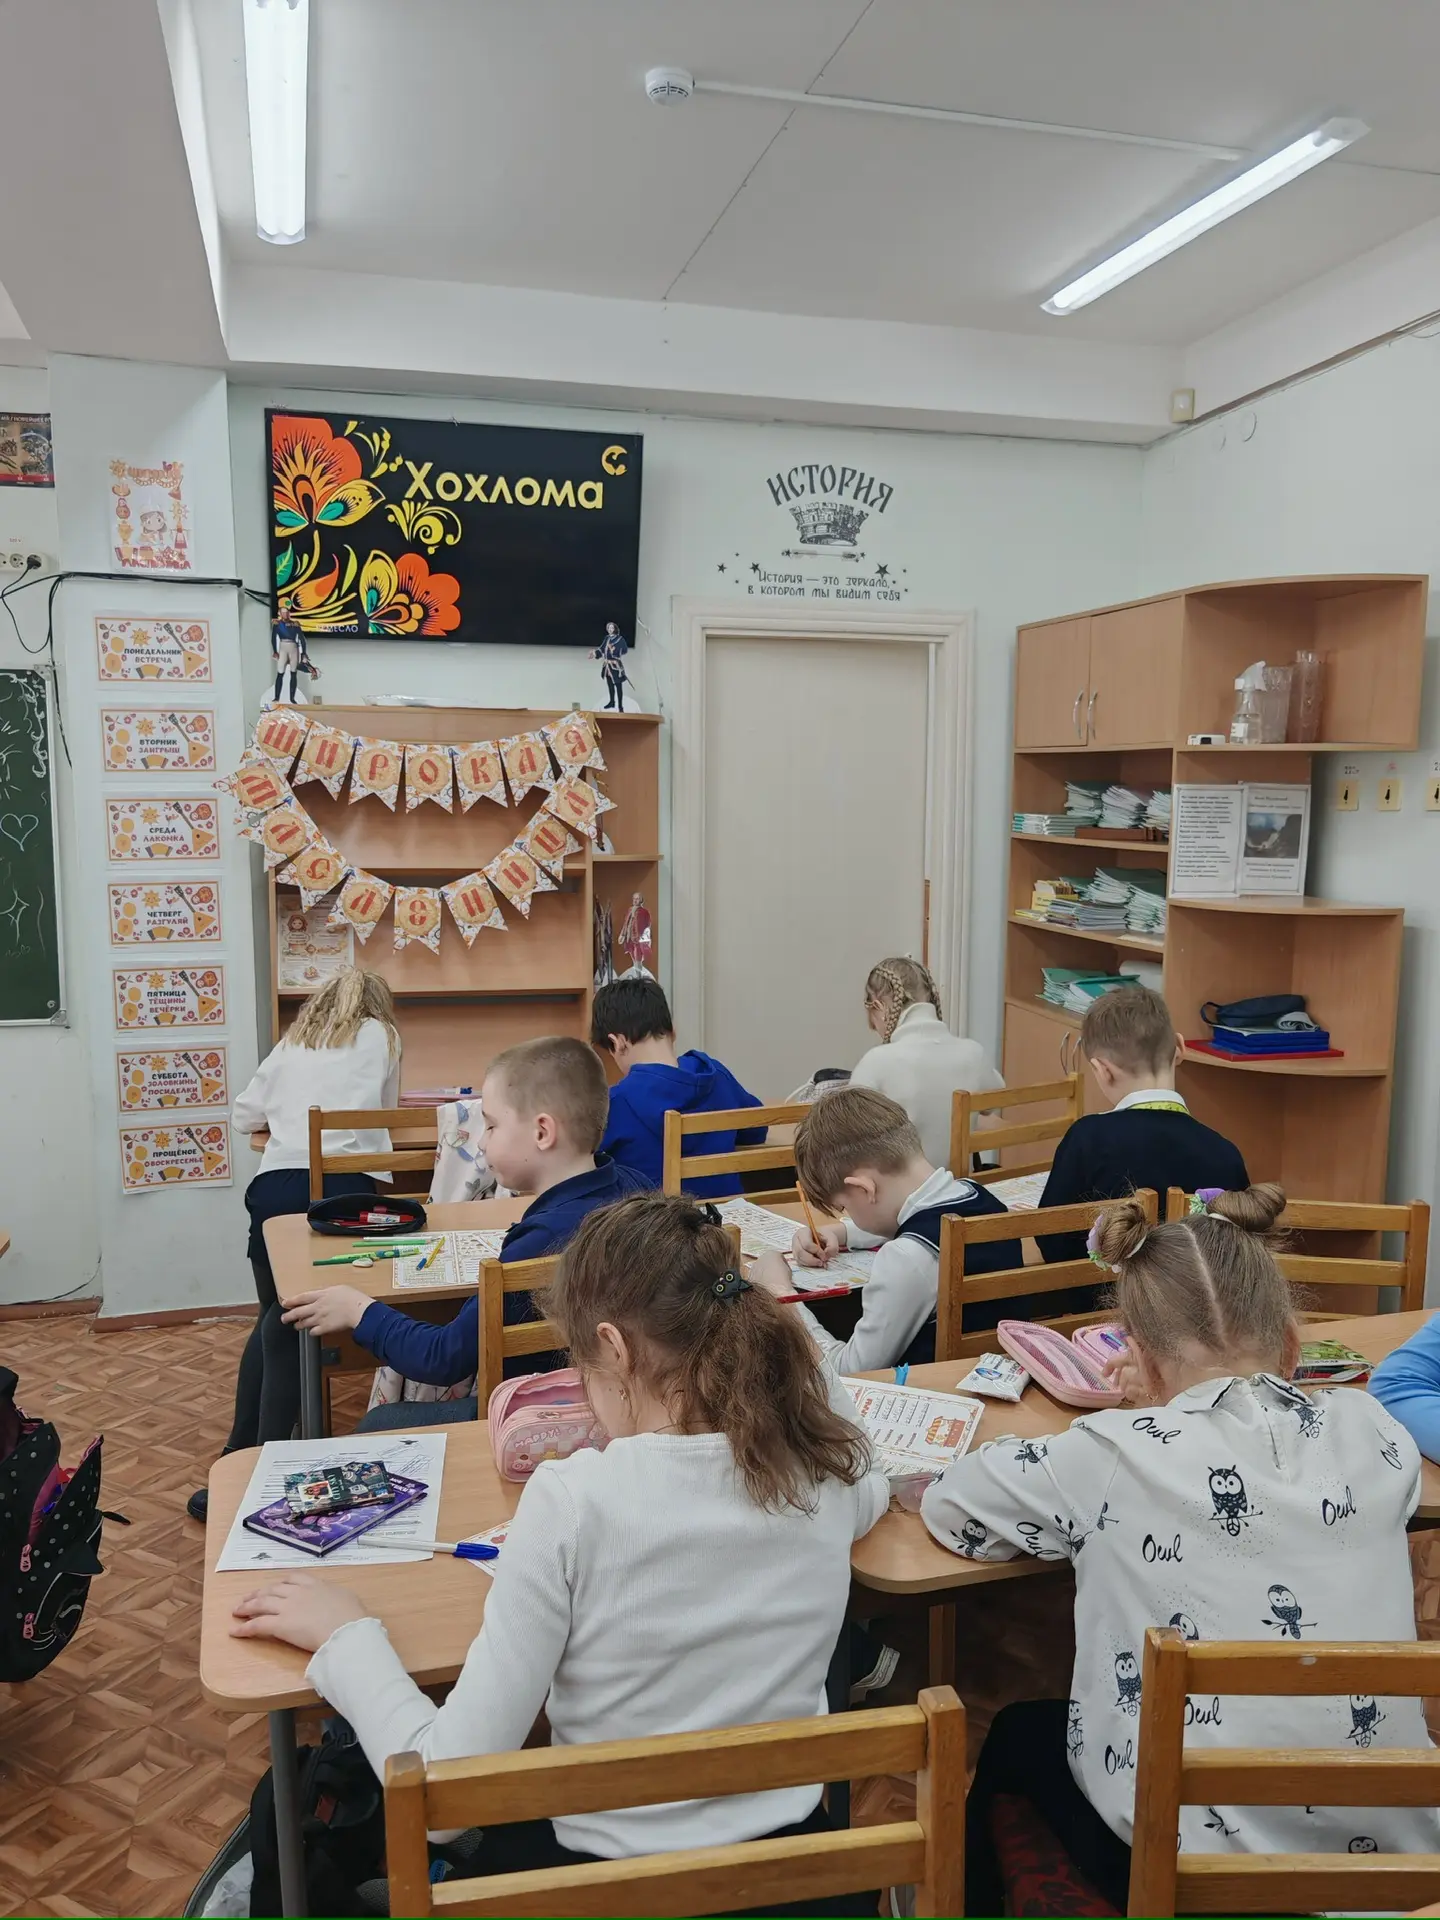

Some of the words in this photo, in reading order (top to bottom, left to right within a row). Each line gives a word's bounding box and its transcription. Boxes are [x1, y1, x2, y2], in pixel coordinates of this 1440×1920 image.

[404, 460, 603, 509] Хохлома
[766, 464, 893, 513] ИСТОРИЯ
[758, 571, 803, 584] История
[823, 576, 840, 586] это
[845, 576, 890, 589] зеркало,
[747, 585, 754, 595] в
[760, 586, 805, 596] котором
[811, 588, 830, 598] мы
[836, 588, 871, 599] видим
[876, 590, 901, 601] себя
[124, 648, 183, 656] ПОНЕДЕЛЬНИК
[135, 656, 173, 664] ВСТРЕЧА
[143, 835, 185, 843] ЛАКОМКА
[147, 910, 183, 918] ЧЕТВЕРГ
[146, 917, 189, 925] РАЗГУЛЯЙ
[147, 990, 187, 998] ПЯТНИЦА
[149, 997, 186, 1005] ТЁЩИНЫ
[149, 1005, 186, 1013] ВЕЧЁРКИ
[152, 1072, 188, 1080] СУББОТА
[147, 1079, 198, 1087] ЗОЛОВКИНЫ
[148, 1087, 198, 1095] ПОСИДЕЛКИ
[1132, 1417, 1181, 1444] Owl
[1321, 1485, 1357, 1526] Owl
[1142, 1534, 1183, 1563] Owl
[1104, 1739, 1135, 1775] Owl
